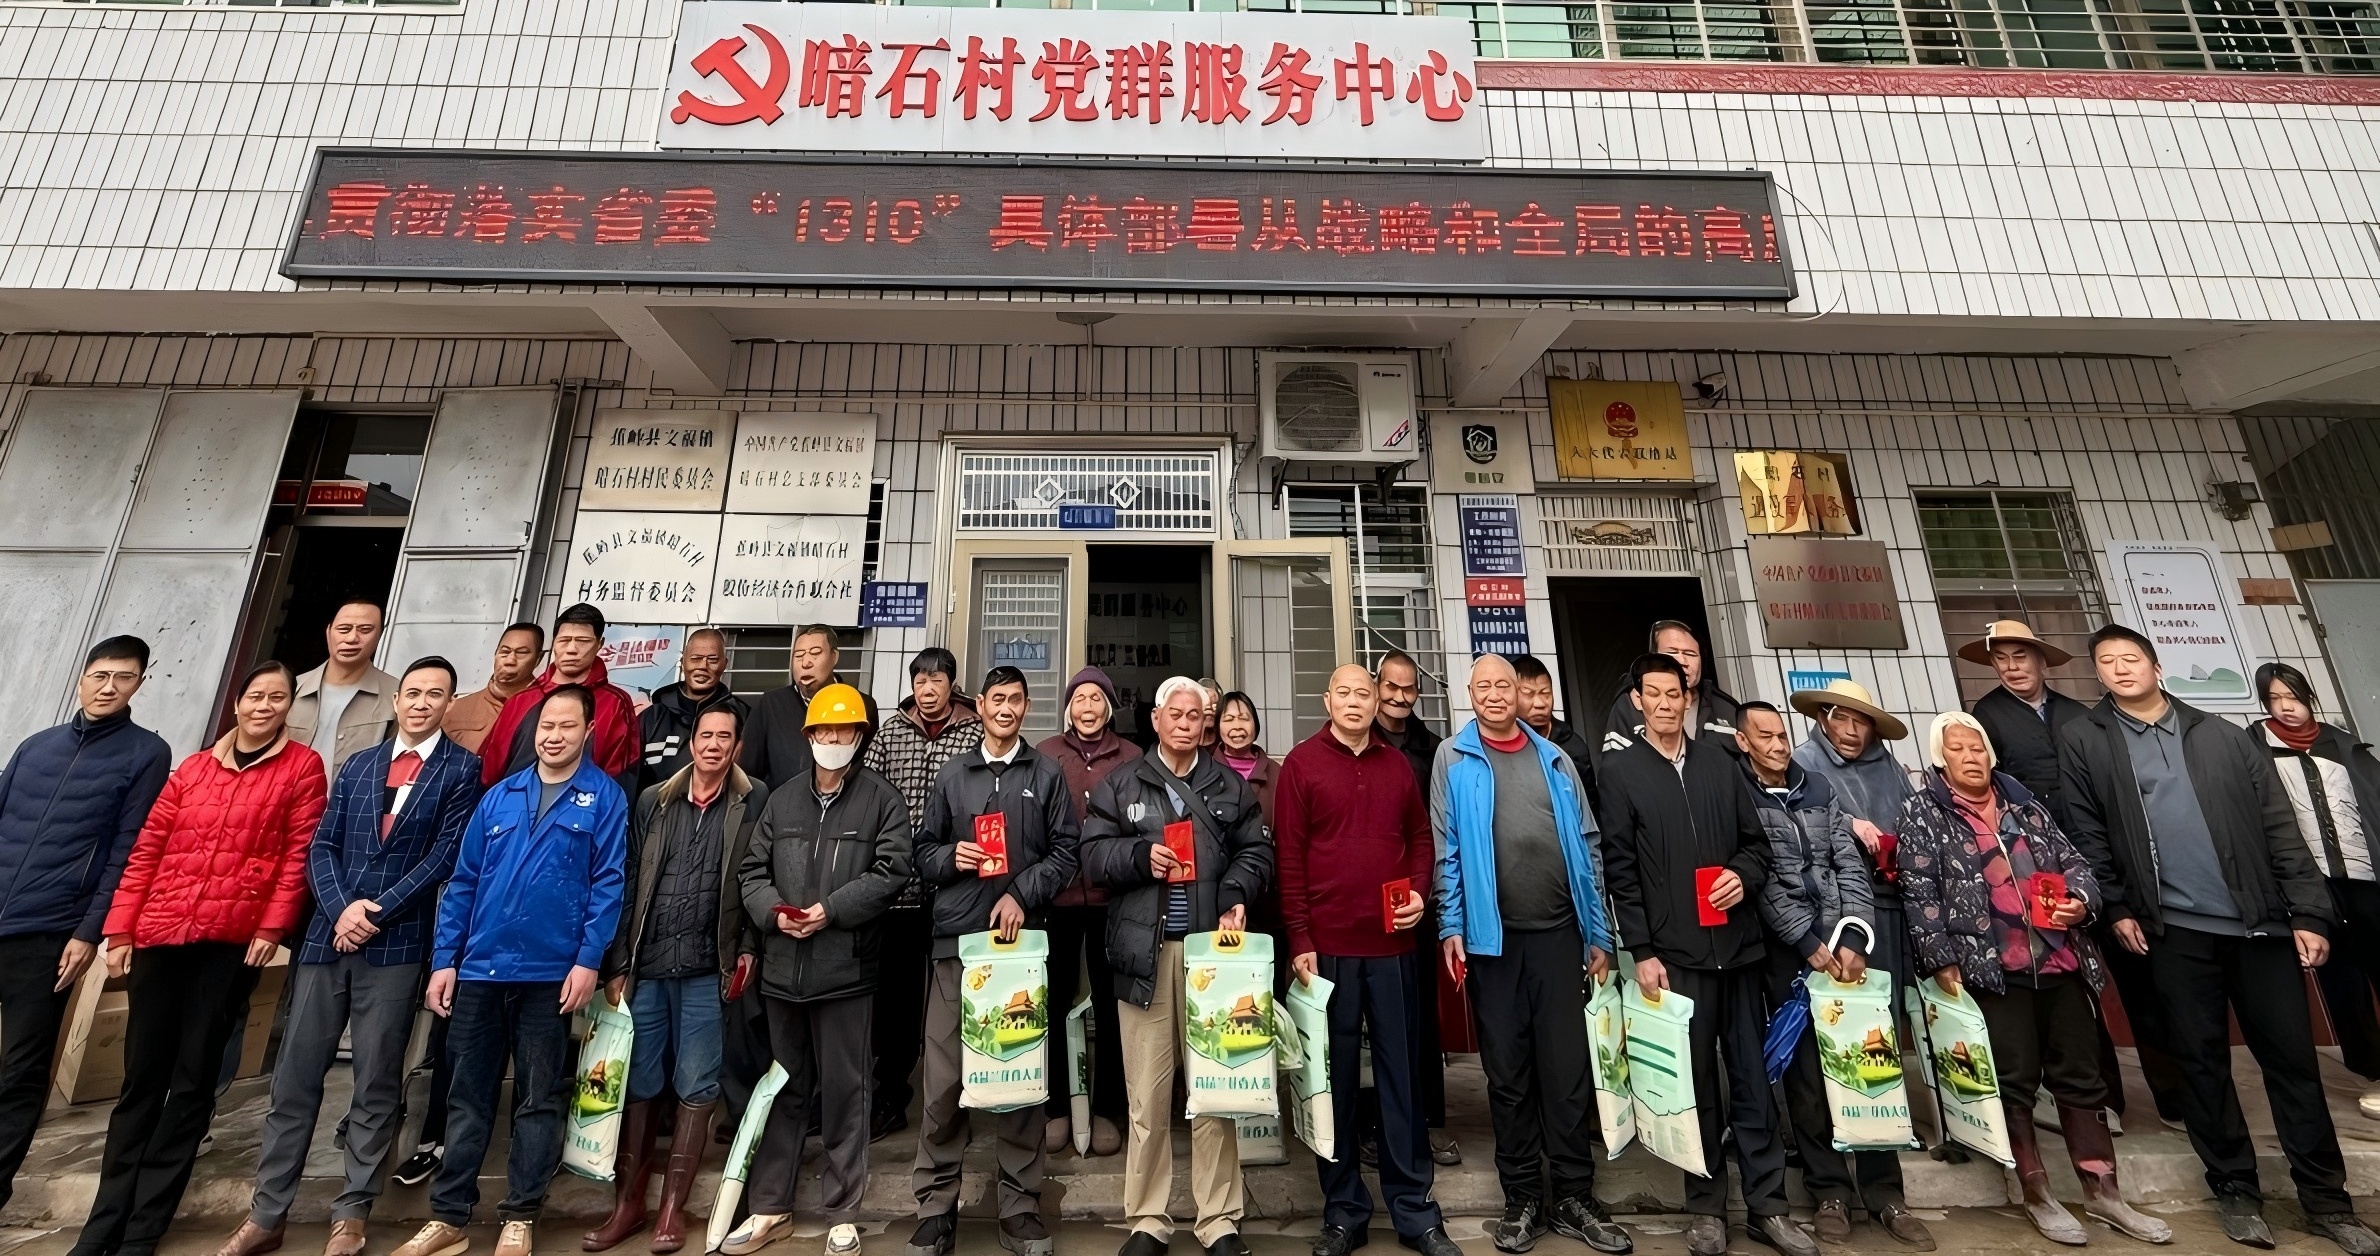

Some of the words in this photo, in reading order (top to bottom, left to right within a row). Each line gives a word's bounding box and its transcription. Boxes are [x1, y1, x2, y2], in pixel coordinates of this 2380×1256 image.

[799, 33, 1473, 126] 暗石村党群服务中心
